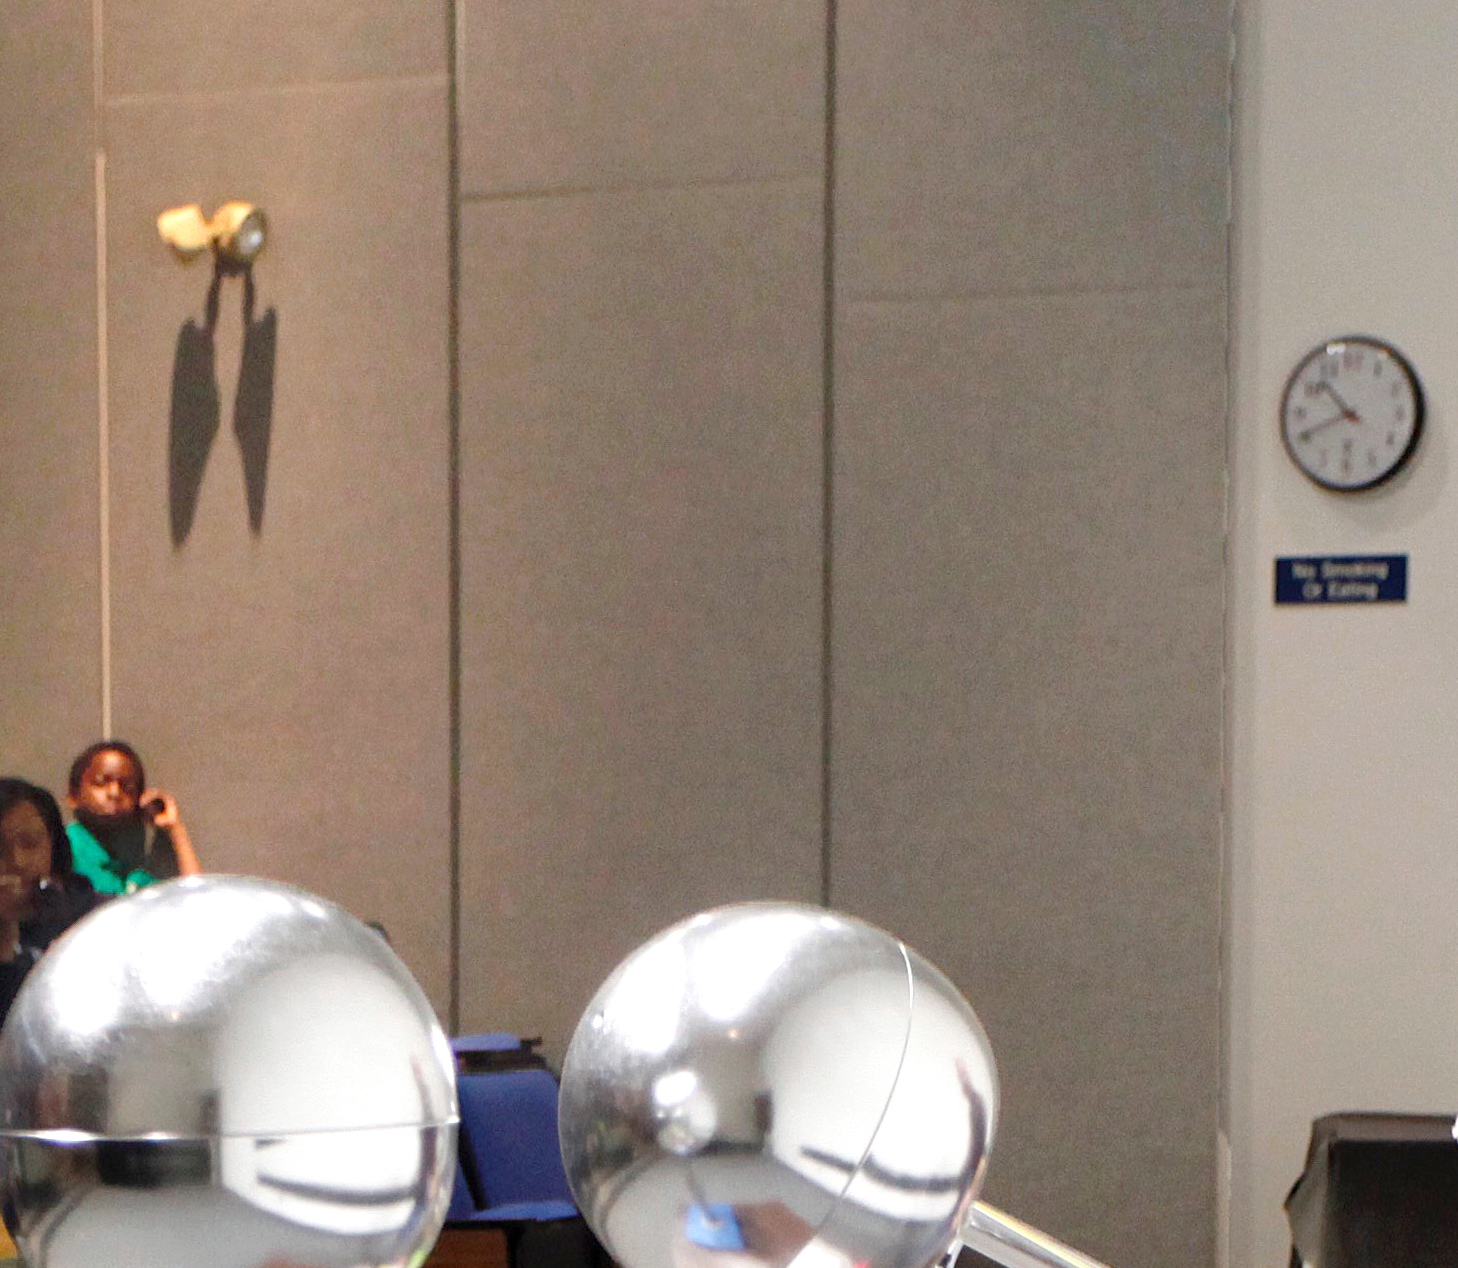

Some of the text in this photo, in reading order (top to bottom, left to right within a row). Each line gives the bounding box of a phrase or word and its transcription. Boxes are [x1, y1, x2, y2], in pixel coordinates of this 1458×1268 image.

[1291, 560, 1390, 581] No Smoking
[1302, 581, 1379, 601] Or Eating
